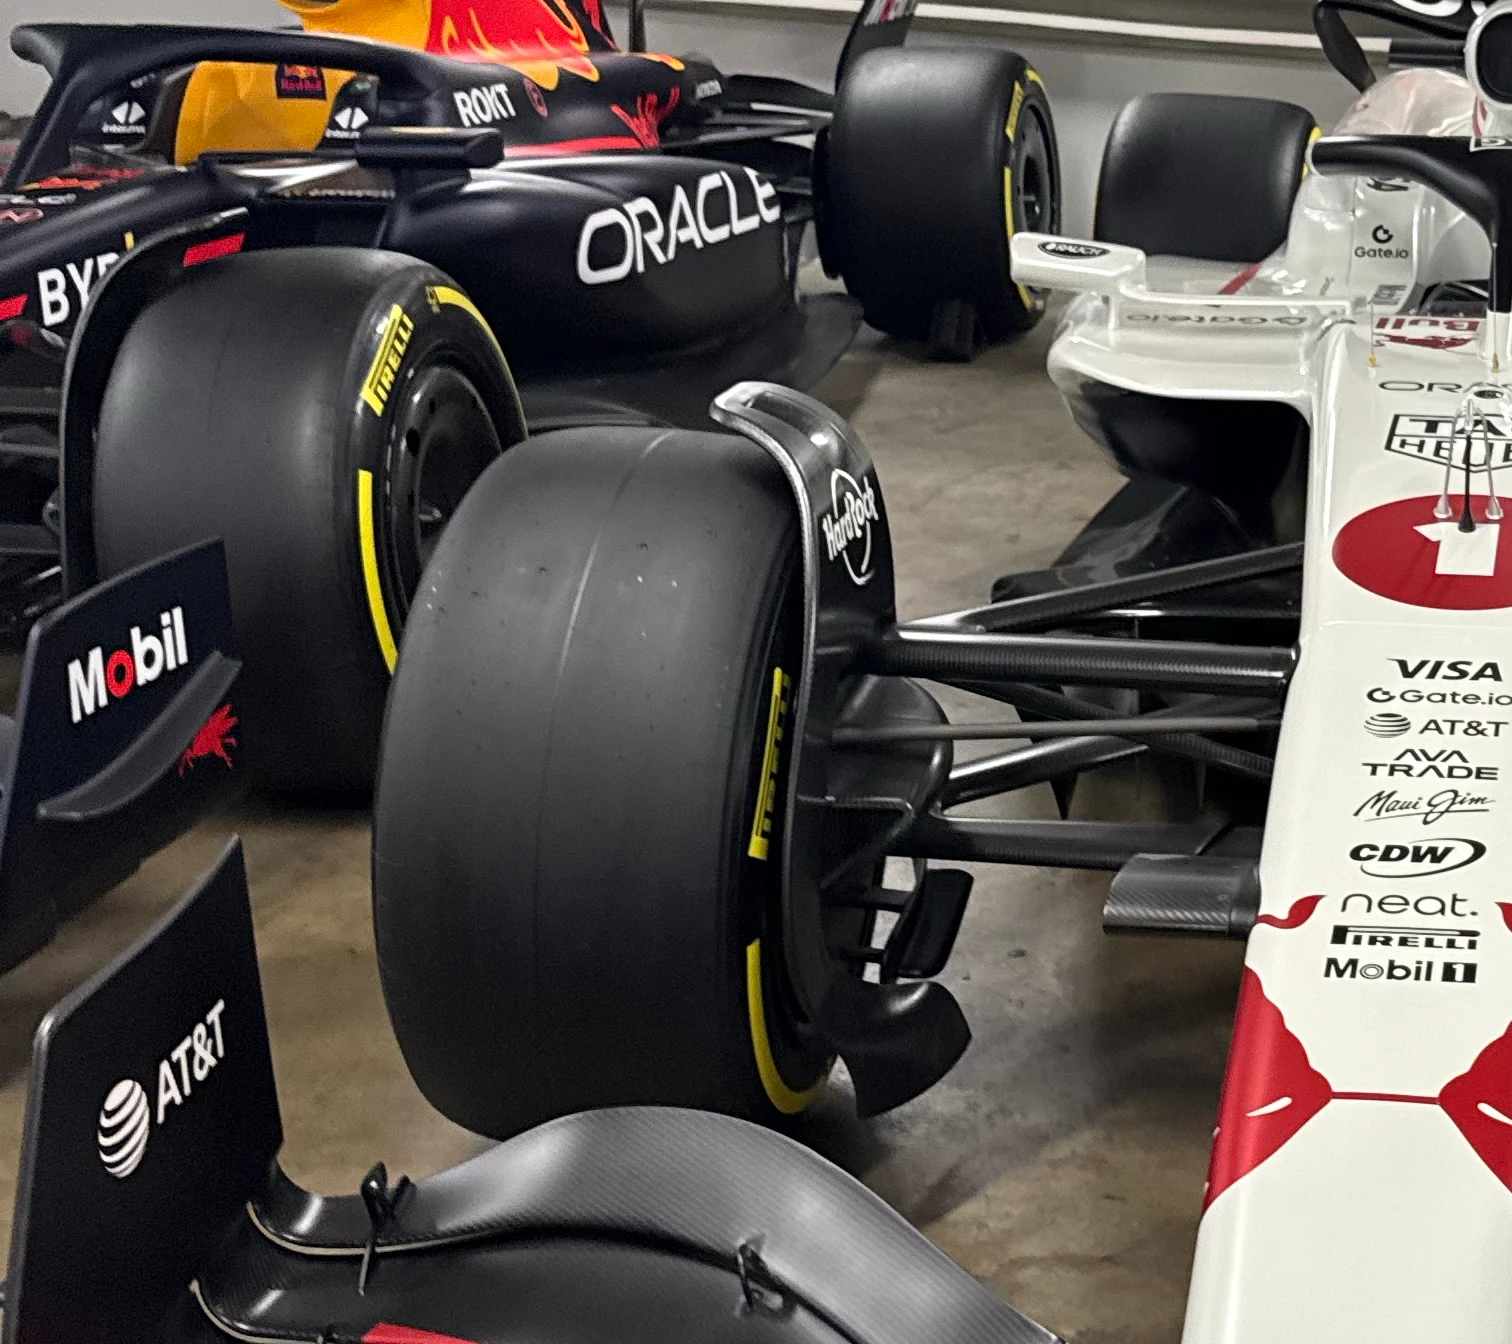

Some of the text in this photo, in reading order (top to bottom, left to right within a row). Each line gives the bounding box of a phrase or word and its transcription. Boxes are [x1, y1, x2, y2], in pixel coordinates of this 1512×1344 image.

[453, 83, 517, 128] ROKT
[575, 165, 781, 285] ORACLE
[1354, 246, 1409, 259] Gate.io
[361, 303, 415, 417] PIRELLI
[1413, 521, 1501, 577] 1
[67, 606, 190, 724] Mobil
[1386, 657, 1504, 682] VISA
[1418, 719, 1510, 737] AT&T
[1393, 748, 1470, 763] AVA
[1361, 762, 1500, 781] TRADE
[1349, 843, 1456, 863] CDW
[1330, 924, 1481, 950] PIRELLI
[1323, 957, 1434, 982] Mobil
[156, 998, 225, 1125] AT&T
